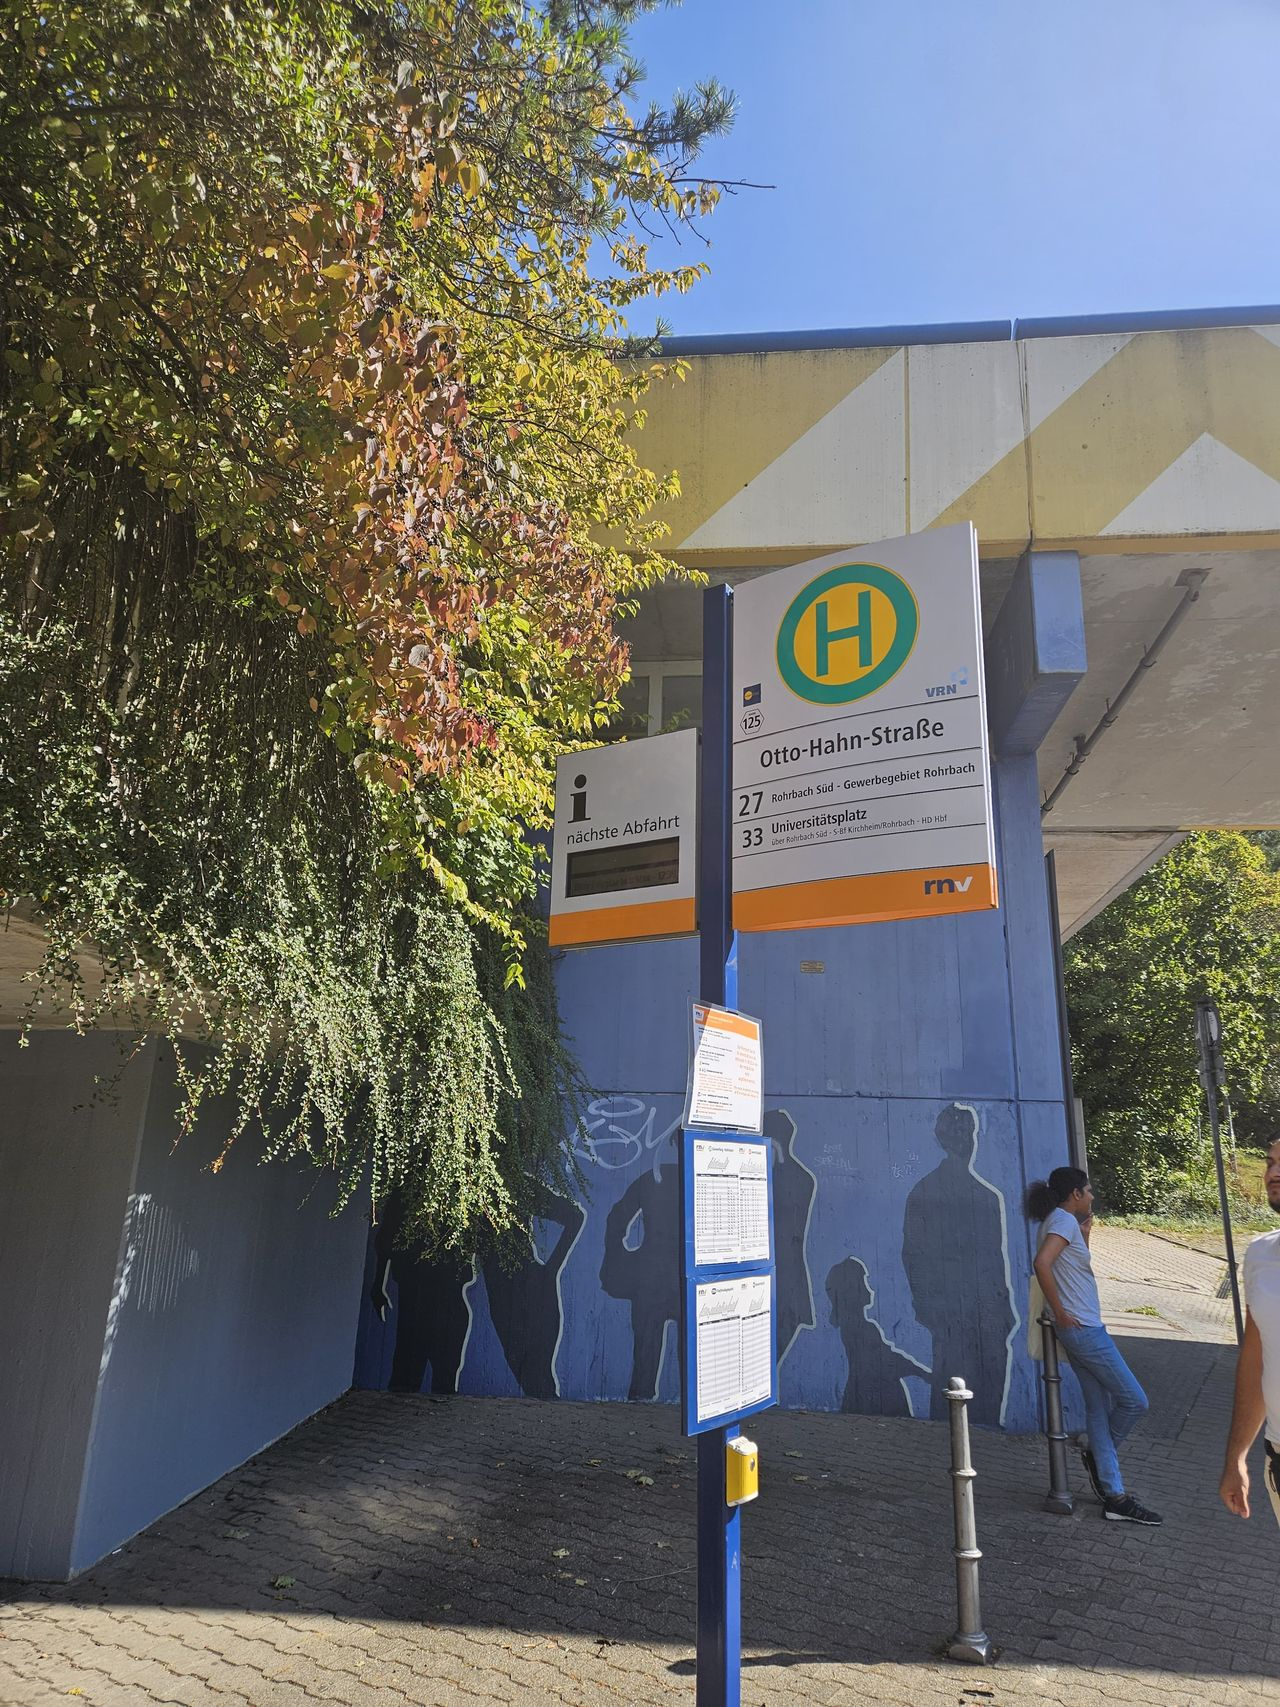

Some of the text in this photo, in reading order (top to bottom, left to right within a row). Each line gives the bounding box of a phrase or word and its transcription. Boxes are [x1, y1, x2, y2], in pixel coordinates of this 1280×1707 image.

[815, 590, 873, 678] H
[925, 684, 957, 698] VRN
[742, 714, 761, 730] 125
[760, 718, 944, 768] Otto-Hahn-Straße
[771, 786, 814, 803] Rohrbach
[816, 782, 834, 795] Süd
[843, 769, 920, 790] Gewerbegebiet
[924, 762, 975, 778] Rohrbach
[739, 791, 764, 817] 27
[567, 815, 680, 845] nächste Abfahrt
[771, 809, 867, 834] Universitätsplatz
[771, 837, 785, 846] über
[786, 831, 815, 844] Rohrbach
[815, 830, 828, 839] Süd
[833, 826, 847, 836] S-Bf
[848, 818, 915, 834] Kirchheim/Rohrbach
[921, 816, 933, 825] HD
[934, 814, 947, 823] Hbf
[742, 827, 763, 848] 33
[924, 876, 973, 896] rnv
